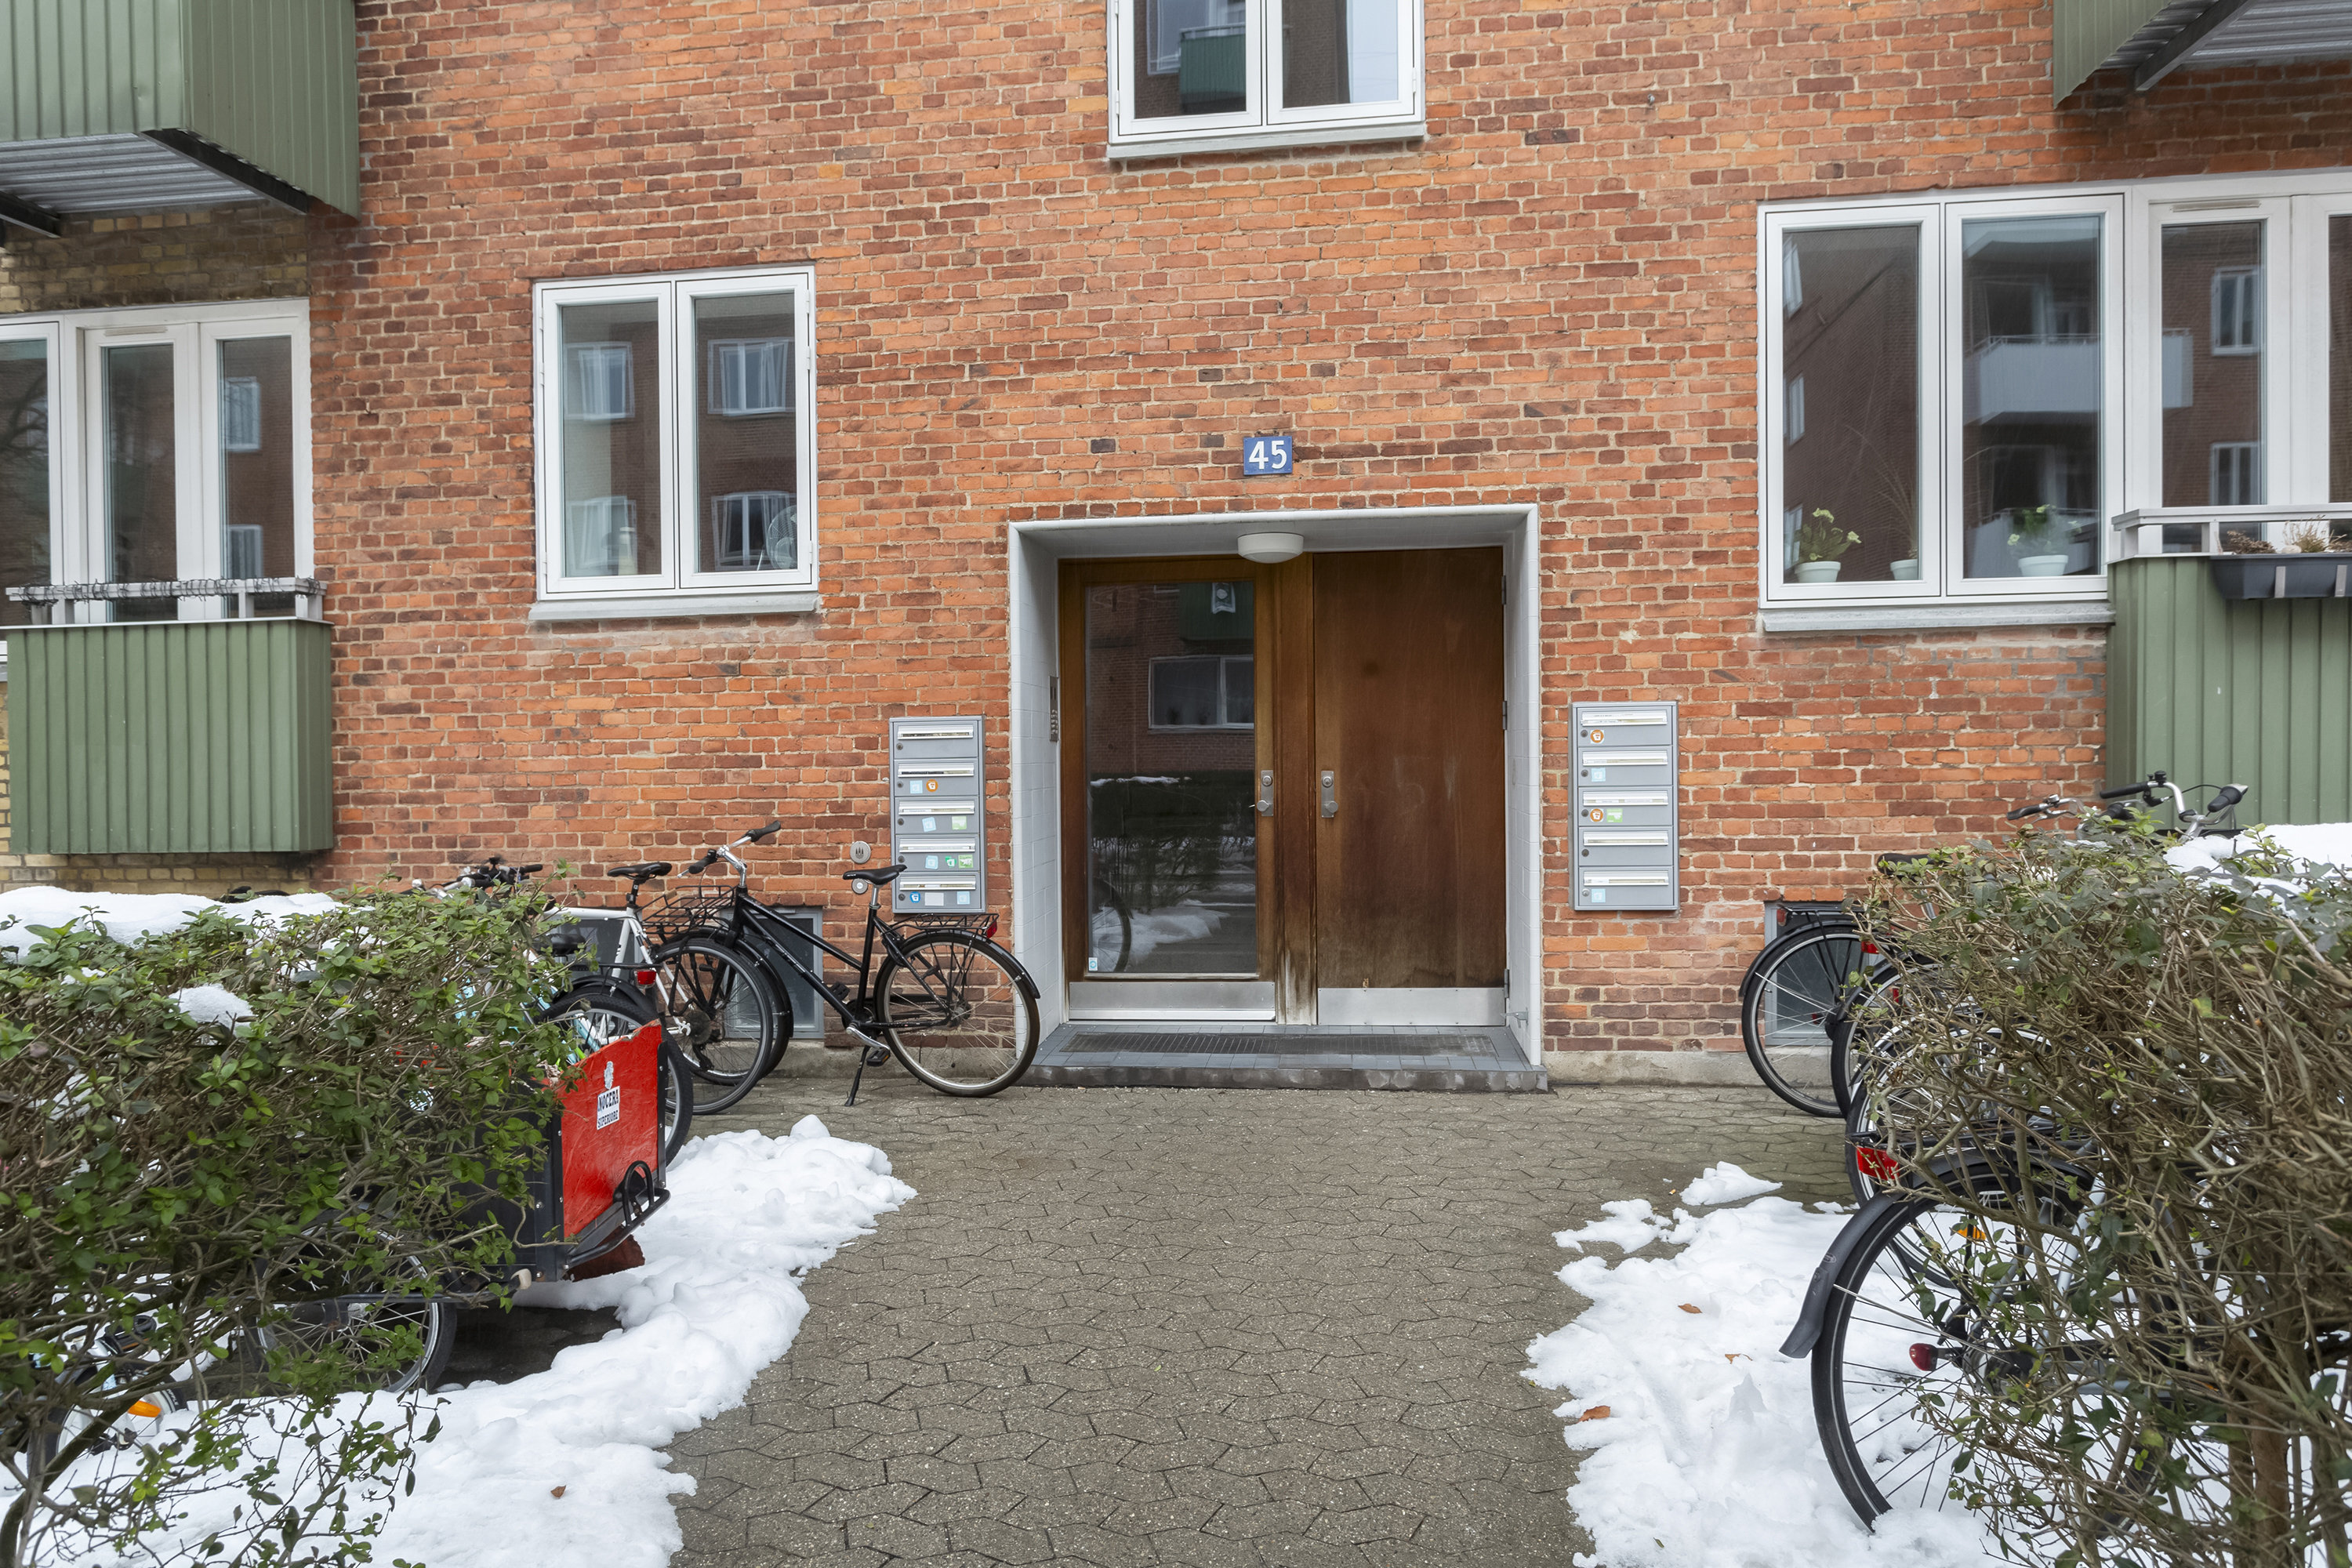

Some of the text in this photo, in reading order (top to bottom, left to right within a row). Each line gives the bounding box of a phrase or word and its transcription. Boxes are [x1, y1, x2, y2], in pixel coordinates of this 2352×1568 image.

[1249, 440, 1287, 470] 45
[597, 1089, 619, 1112] NOCERA
[597, 1109, 619, 1128] SUPERIORE
